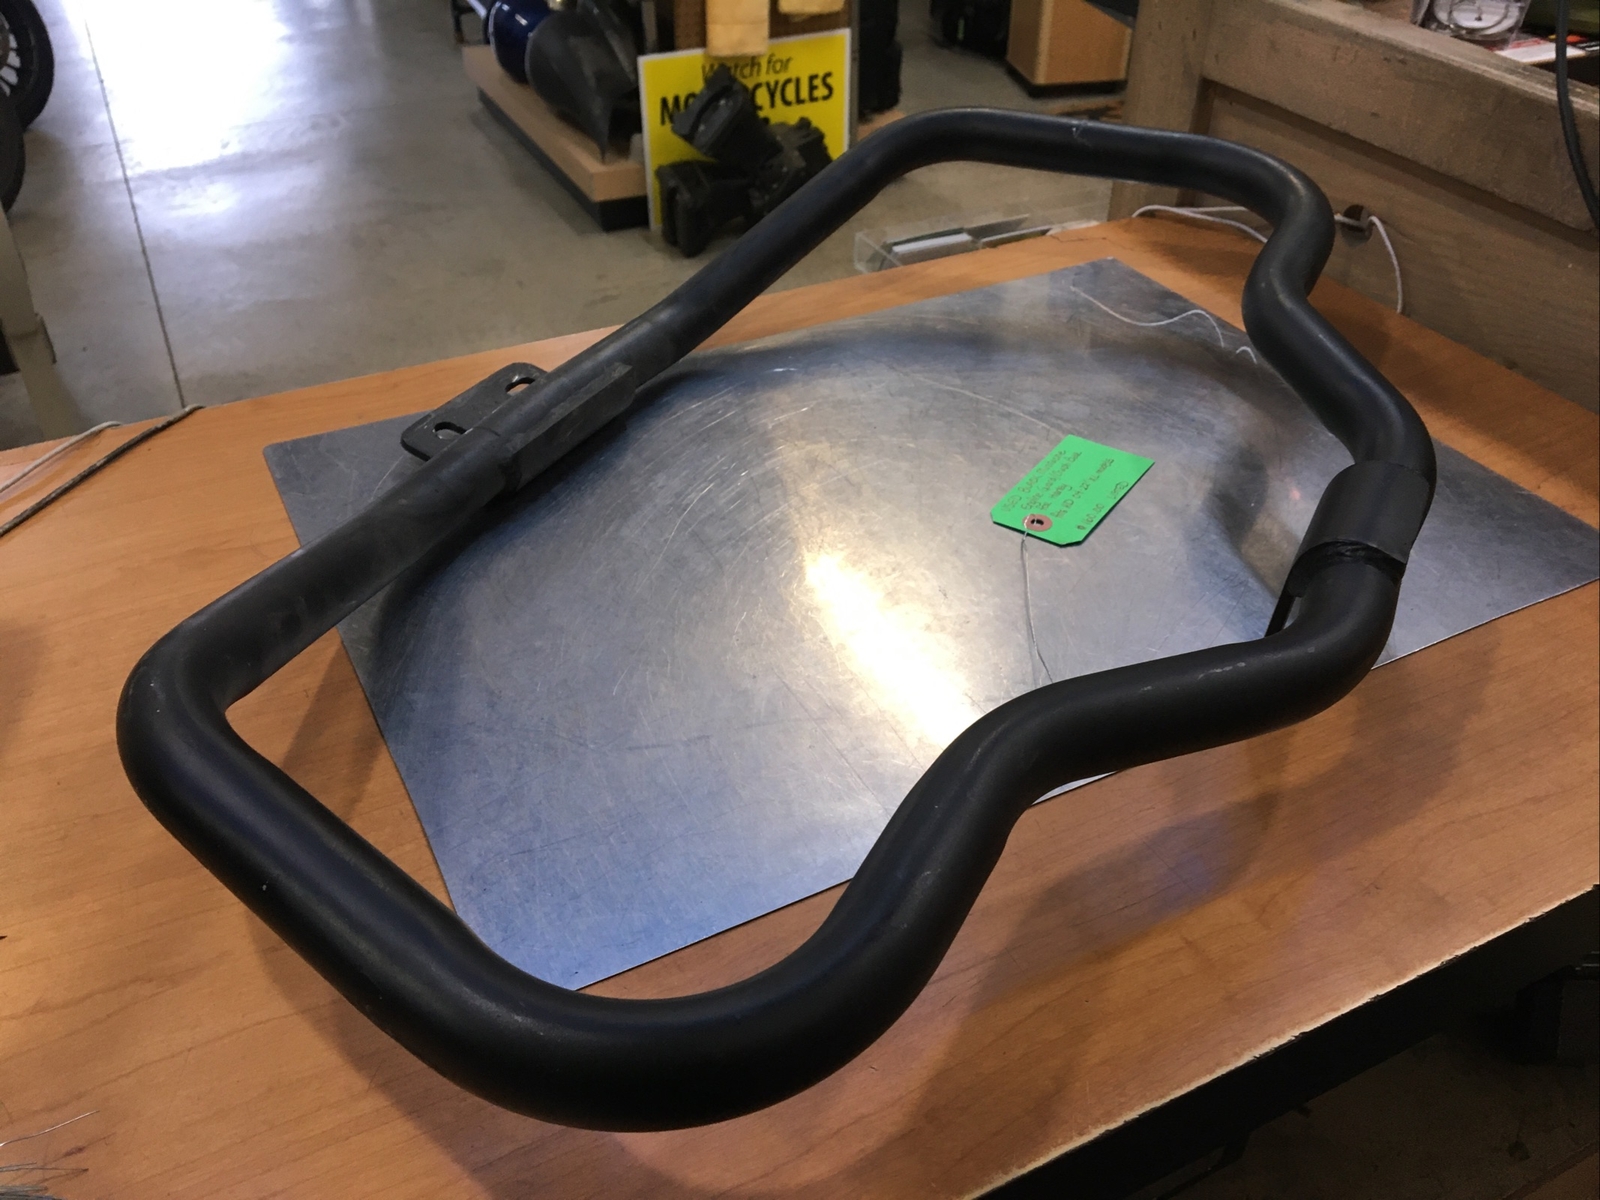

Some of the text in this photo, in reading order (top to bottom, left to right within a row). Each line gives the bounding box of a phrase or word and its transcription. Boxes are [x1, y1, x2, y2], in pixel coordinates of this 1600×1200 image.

[701, 53, 793, 79] tch for
[660, 72, 834, 126] MCYCLES
